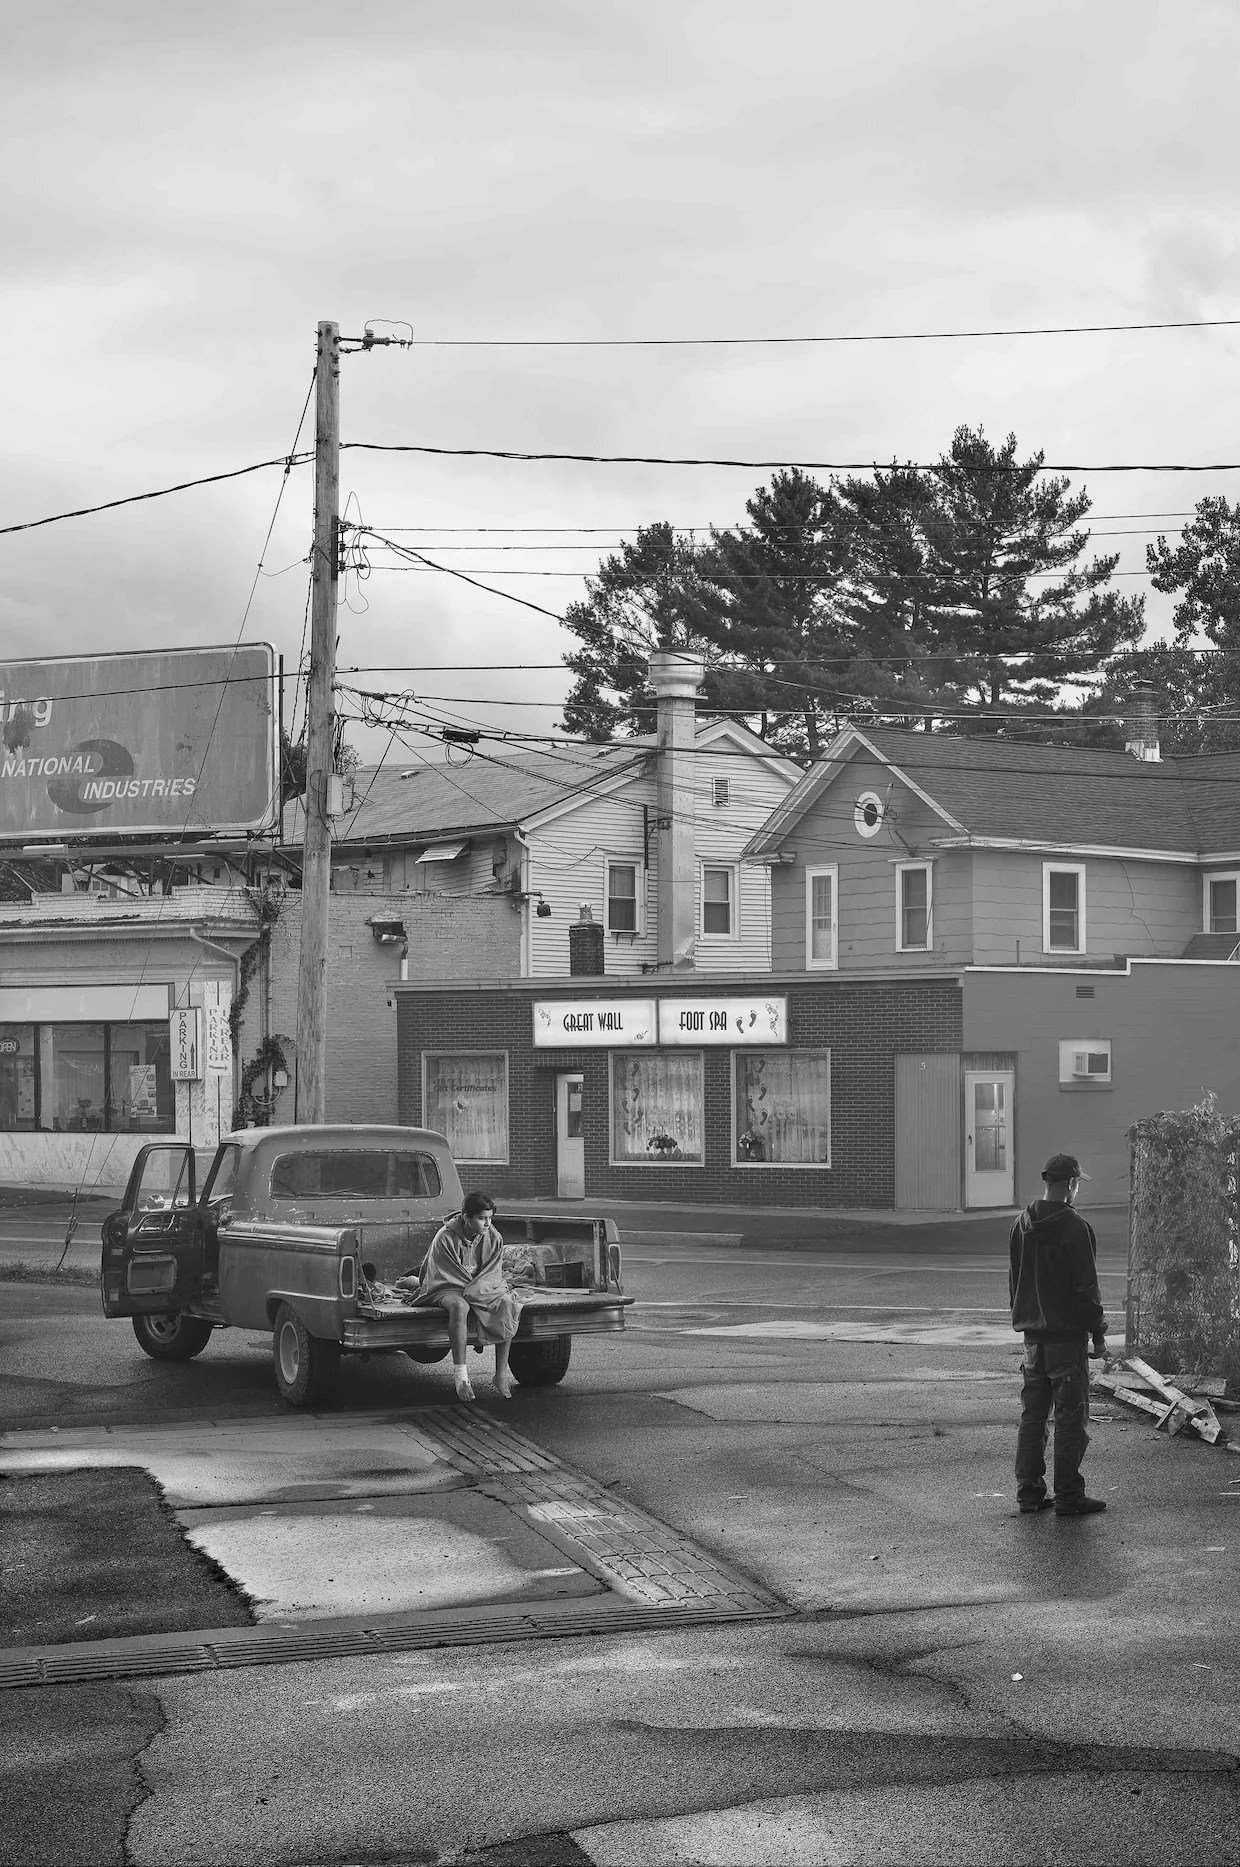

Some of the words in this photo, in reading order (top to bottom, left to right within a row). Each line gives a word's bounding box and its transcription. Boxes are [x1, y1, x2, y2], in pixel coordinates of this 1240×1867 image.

[1, 755, 96, 778] NATIONAL
[83, 777, 197, 800] INDUSTRIES
[219, 1009, 230, 1025] IN
[563, 1013, 594, 1032] GREAT
[597, 1012, 624, 1032] WALL
[678, 1011, 705, 1031] FOOT
[709, 1011, 727, 1031] SPA
[179, 1012, 188, 1069] PARKING
[208, 1009, 219, 1061] PARKING
[220, 1028, 230, 1061] REAR
[179, 1070, 196, 1078] REAR
